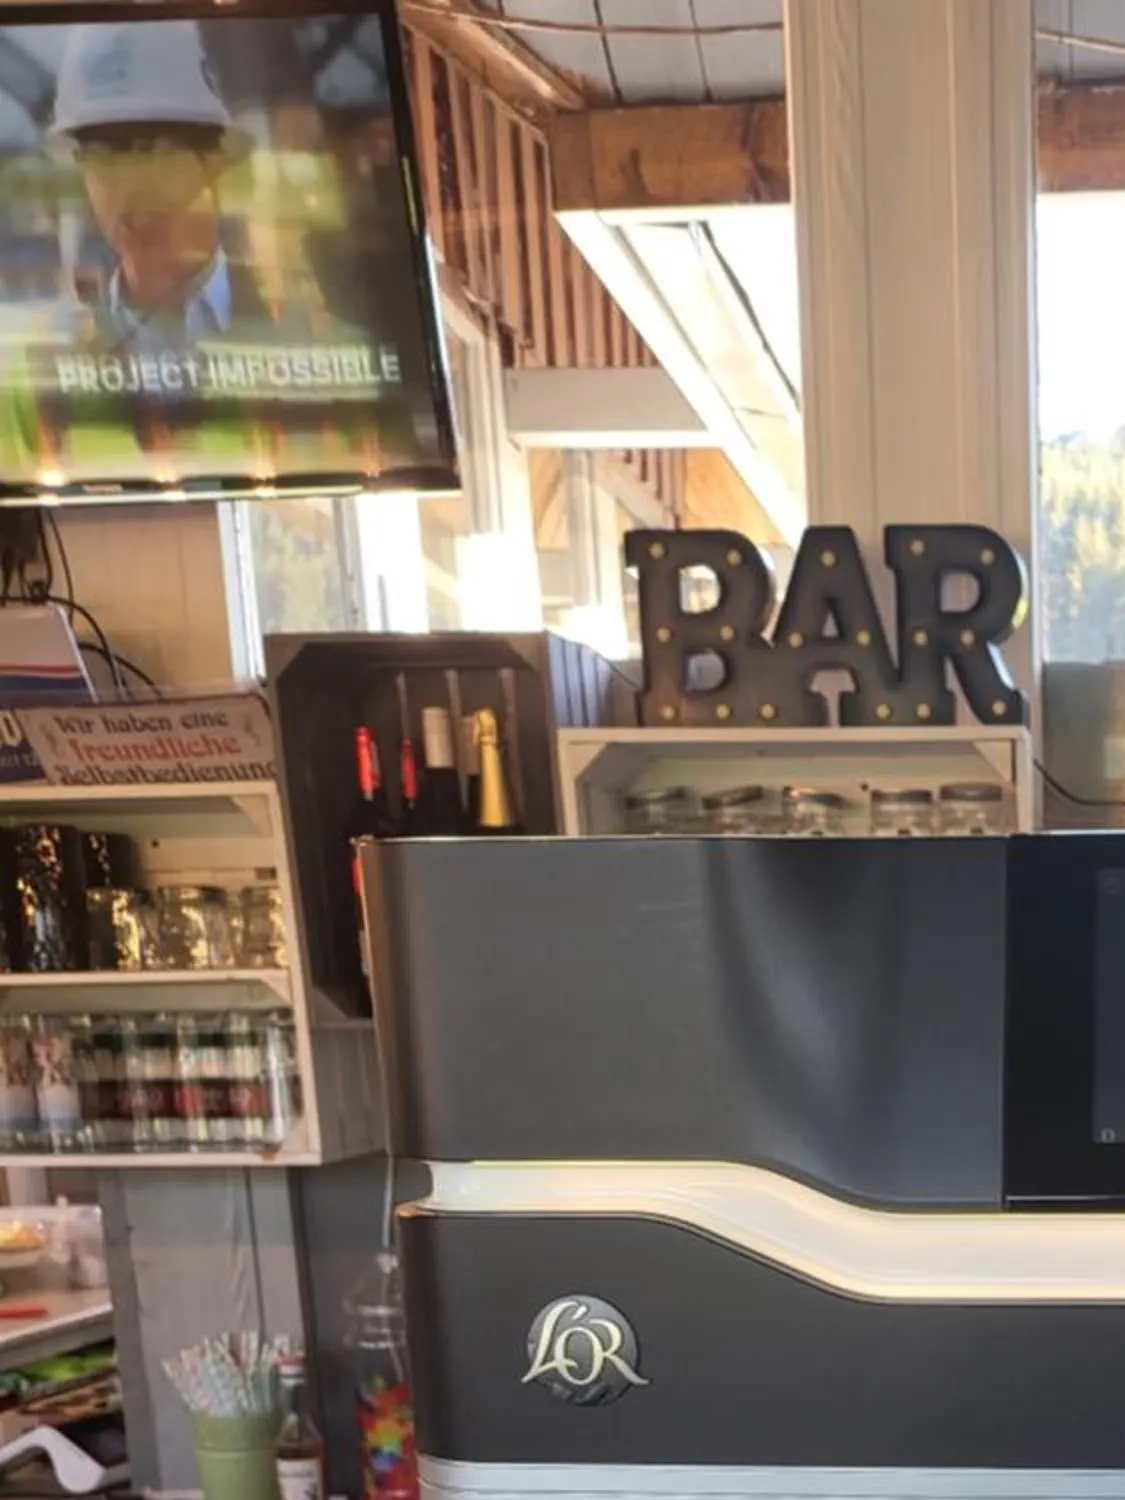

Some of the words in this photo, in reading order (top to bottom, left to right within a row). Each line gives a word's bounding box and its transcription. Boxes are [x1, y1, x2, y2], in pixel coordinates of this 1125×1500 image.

[56, 353, 201, 394] PROJECT
[207, 350, 401, 389] IMPOSSIBLE
[624, 524, 1026, 728] BAR
[53, 714, 96, 735] Wir
[100, 710, 173, 733] haben
[181, 710, 230, 730] eine
[68, 733, 242, 764] freundliche
